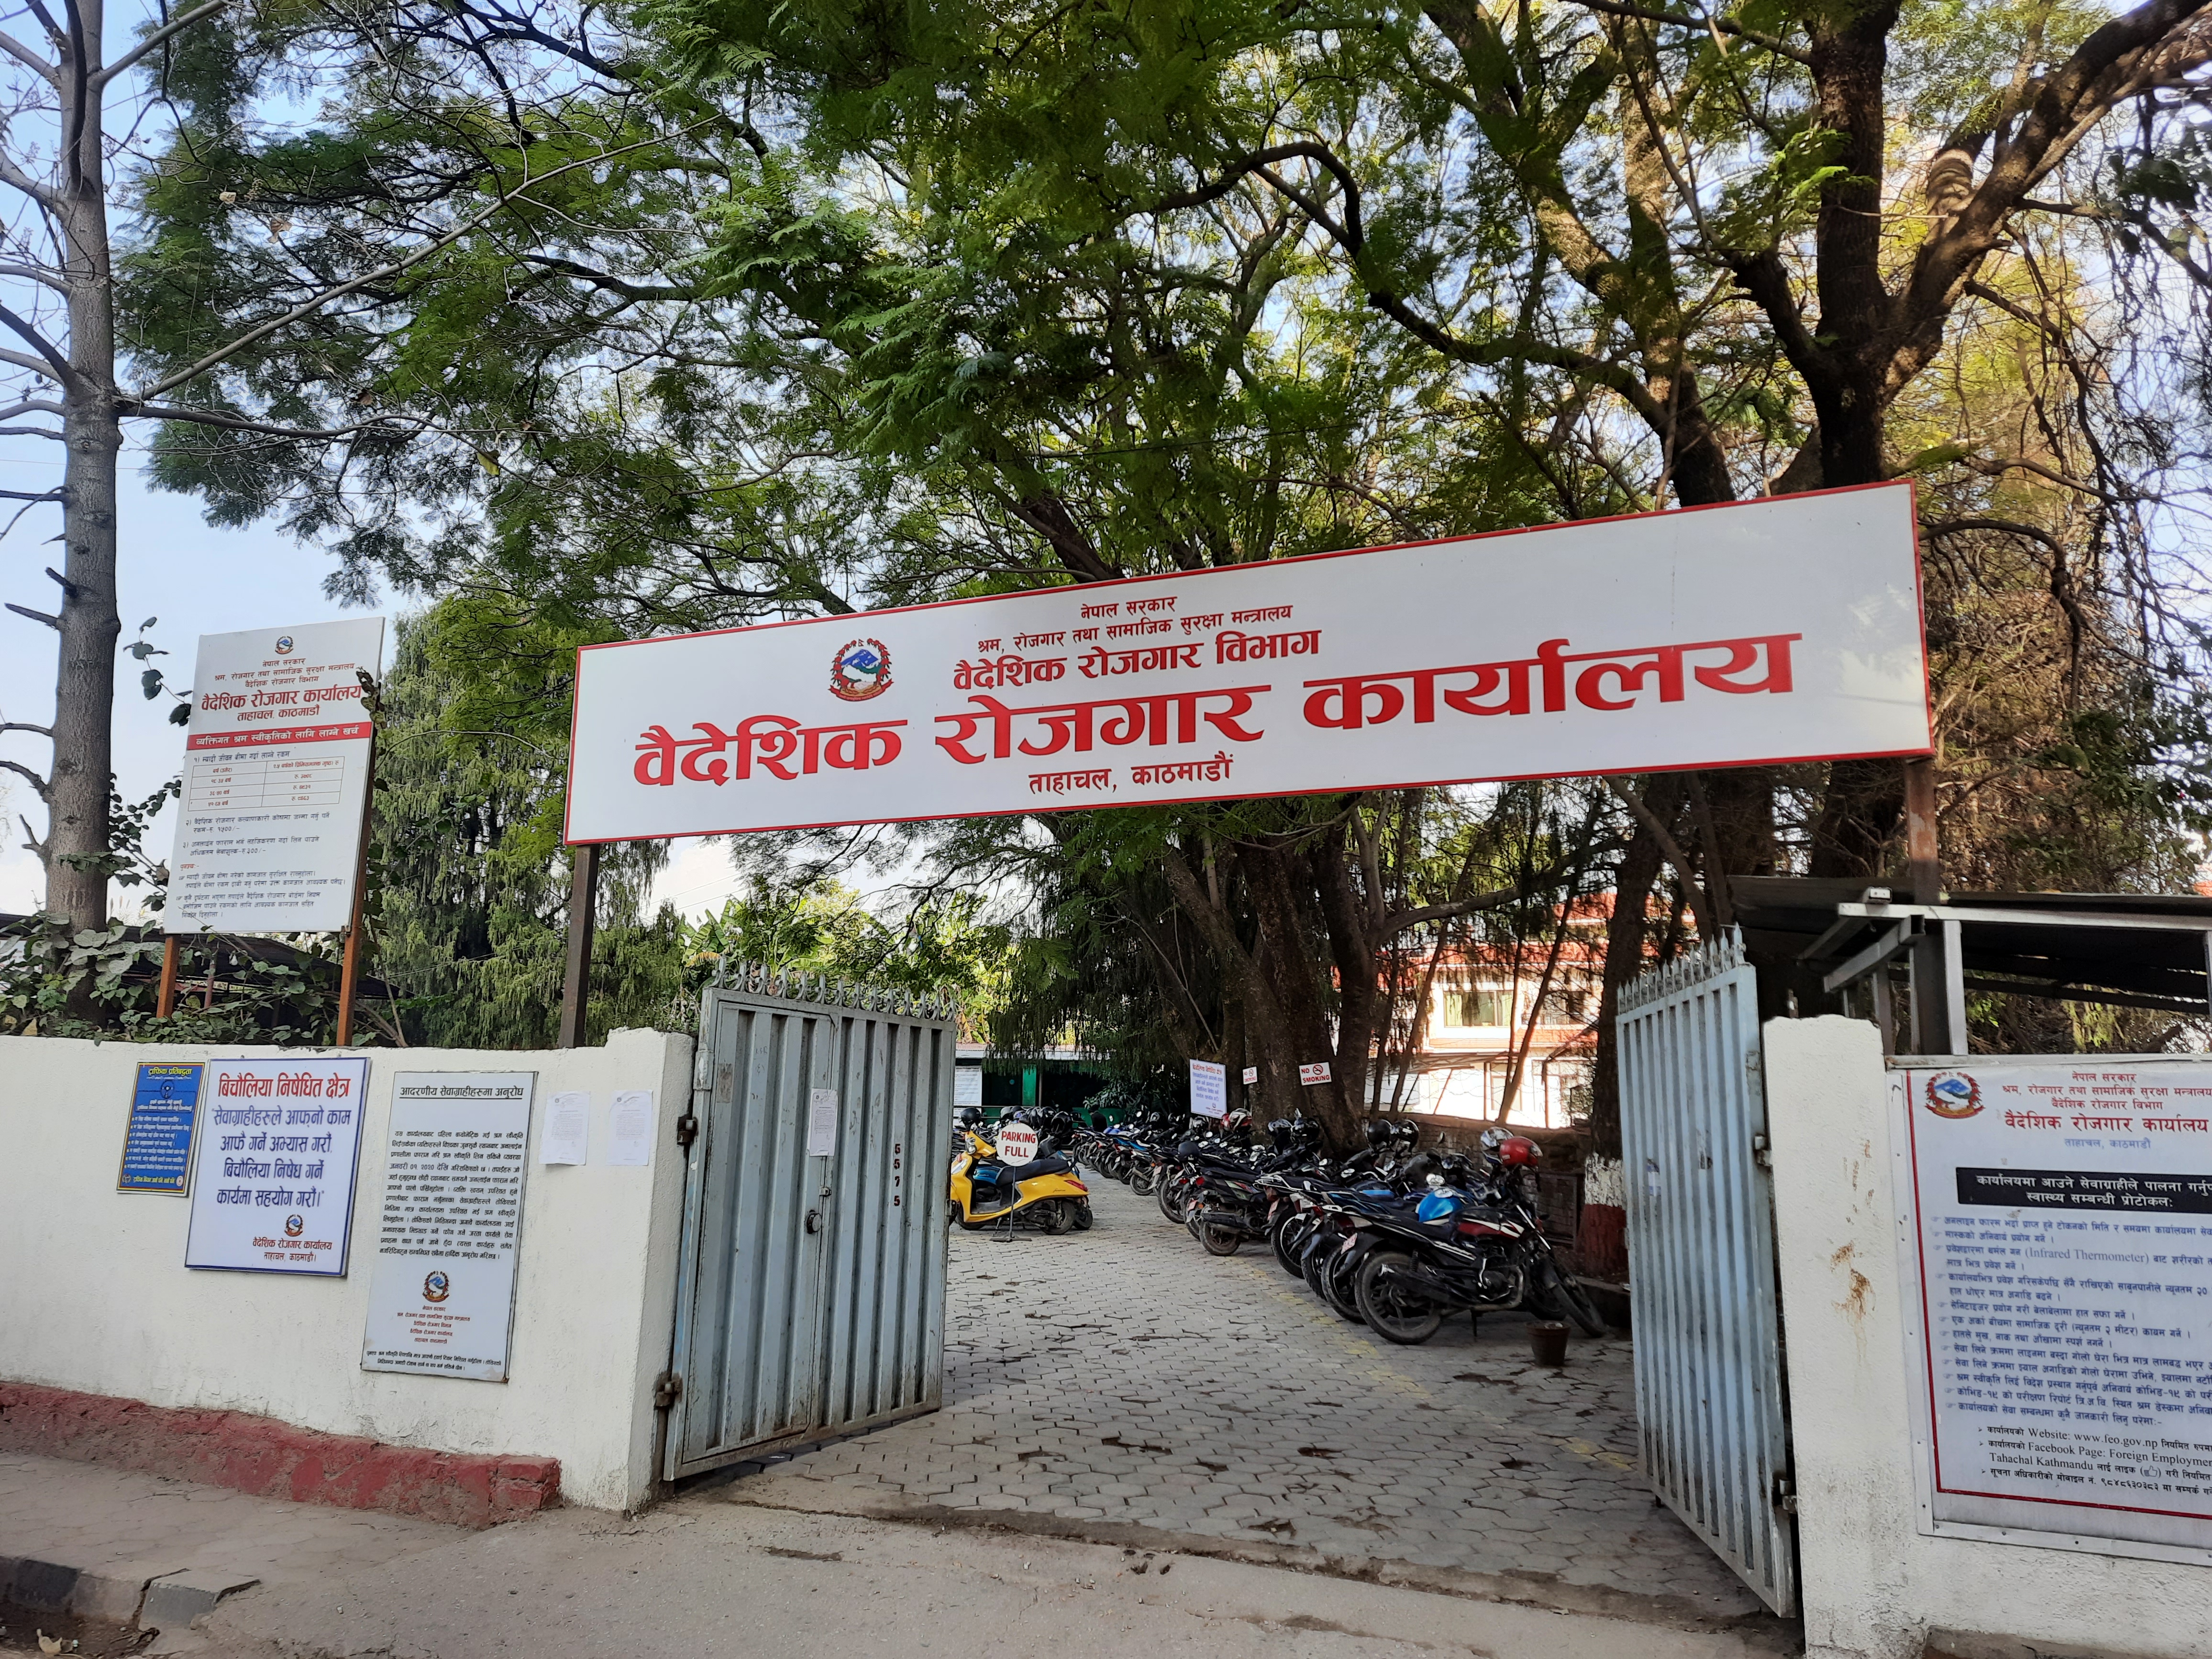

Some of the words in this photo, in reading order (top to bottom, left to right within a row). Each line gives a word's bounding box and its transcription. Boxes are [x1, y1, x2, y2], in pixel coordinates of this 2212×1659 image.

[1081, 603, 1119, 619] नेपाल
[1126, 597, 1177, 616] सरकार
[978, 639, 1004, 654] श्रम,
[1013, 631, 1066, 651] रोजगार
[1072, 628, 1100, 643] तथा
[1106, 617, 1173, 640] सामाजिक
[1180, 613, 1224, 635] सुरक्षा
[1231, 605, 1293, 624] मन्त्रालय
[954, 655, 1067, 690] वैदेशिक
[1078, 643, 1204, 678] रोजगार
[1215, 630, 1322, 664] विभाग
[231, 672, 255, 680] रोजगार
[273, 667, 303, 675] सामाजिक
[306, 666, 325, 675] सुरक्षा
[245, 679, 268, 688] वैदेशिक
[271, 678, 296, 686] रोजगार
[201, 692, 247, 711] वैदेशिक
[251, 689, 300, 708] रोजगार
[303, 684, 362, 702] कार्यालय
[634, 715, 908, 786] वैदेशिक
[934, 685, 1272, 764] रोजगार
[1302, 631, 1803, 730] कार्यालय
[196, 735, 230, 745] व्यक्तिगत
[251, 730, 292, 743] स्वीकृतिको
[295, 728, 316, 739] लागि
[319, 727, 340, 737] लाग्ने
[343, 725, 359, 735] खर्च
[1028, 769, 1117, 796] ताहाचल,
[1130, 751, 1234, 785] काठमाडौं
[218, 1073, 274, 1098] बिचौलिया
[276, 1072, 323, 1097] निषेधित
[326, 1073, 351, 1099] क्षेत्र
[1303, 1075, 1330, 1083] SMOKING
[2072, 1071, 2096, 1082] नेपाल
[2102, 1073, 2136, 1083] सरकार
[400, 1085, 438, 1095] आदरणीय
[495, 1085, 524, 1097] अनुरोध
[2002, 1085, 2021, 1095] श्रम,
[2027, 1084, 2064, 1095] रोजगार
[2069, 1086, 2086, 1095] तथा
[2092, 1084, 2135, 1095] सामाजिक
[2140, 1087, 2168, 1099] सुरक्षा
[2174, 1088, 2212, 1096] मन्त्रालय
[2051, 1096, 2085, 1108] वैदेशिक
[2090, 1098, 2128, 1110] रोजगार
[2133, 1098, 2163, 1110] विभाग
[327, 1110, 352, 1125] काम
[2004, 1109, 2062, 1129] वैदेशिक
[2070, 1113, 2133, 1132] रोजगार
[2142, 1114, 2209, 1133] कार्यालय
[220, 1131, 246, 1151] आफै
[249, 1131, 267, 1151] गर्ने
[269, 1136, 309, 1153] अभ्यास
[1002, 1131, 1036, 1143] PARKING
[2065, 1139, 2104, 1149] ताहाचल,
[1005, 1145, 1029, 1158] FULL
[223, 1157, 271, 1179] बिचौलिया
[274, 1158, 302, 1179] निषेध
[305, 1159, 324, 1179] गर्ने
[437, 1162, 449, 1171] देखि
[1976, 1173, 2036, 1187] कार्यालयमा
[2042, 1175, 2074, 1188] आउने
[2079, 1176, 2139, 1190] सेवाग्राहीले
[2144, 1182, 2182, 1192] पालना
[217, 1185, 252, 1205] कार्यमा
[255, 1186, 293, 1207] सहयोग
[2026, 1192, 2065, 1203] स्वास्थ्य
[2070, 1192, 2115, 1205] सम्बन्धी
[253, 1237, 276, 1248] वैदेशिक
[277, 1238, 302, 1249] रोजगार
[303, 1239, 332, 1250] कार्यालय
[2025, 1247, 2070, 1259] (Infrared
[2074, 1249, 2149, 1264] Thermometer)
[2171, 1254, 2203, 1265] शरीरको
[1951, 1316, 1964, 1325] एक
[2016, 1319, 2050, 1329] सामाजिक
[2106, 1326, 2110, 1335] २
[2114, 1324, 2138, 1336] मीटर)
[2142, 1328, 2165, 1336] कायम
[2002, 1390, 2013, 1399] को
[2016, 1391, 2046, 1402] परीक्षण
[2049, 1393, 2071, 1404] रिपोर्ट
[2112, 1397, 2132, 1408] स्थित
[2155, 1401, 2184, 1412] डेस्कमा
[1958, 1401, 1998, 1413] कार्यालयको
[2002, 1405, 2015, 1414] सेवा
[2020, 1408, 2054, 1416] सम्बन्धमा
[2057, 1408, 2070, 1421] कुनै
[2074, 1412, 2109, 1422] जानकारी
[1987, 1426, 2024, 1436] कार्यालयको
[2028, 1428, 2070, 1440] Website:
[2074, 1434, 2157, 1449] www.feo.gov.np
[2161, 1438, 2189, 1449] नियमित
[1988, 1439, 2025, 1449] कार्यालयको
[2028, 1442, 2075, 1454] Facebook
[2079, 1446, 2105, 1459] Page:
[2110, 1449, 2148, 1463] Foreign
[1990, 1452, 2033, 1465] Tahachal
[2036, 1457, 2093, 1470] Kathmandu
[2097, 1462, 2111, 1472] लाई
[2114, 1466, 2136, 1474] लाइक
[2165, 1469, 2179, 1478] गरी
[2182, 1469, 2211, 1481] नियमित
[1990, 1469, 2011, 1478] सूचना
[2014, 1469, 2053, 1480] अधिकारीको
[2175, 1485, 2199, 1494] सम्पर्क
